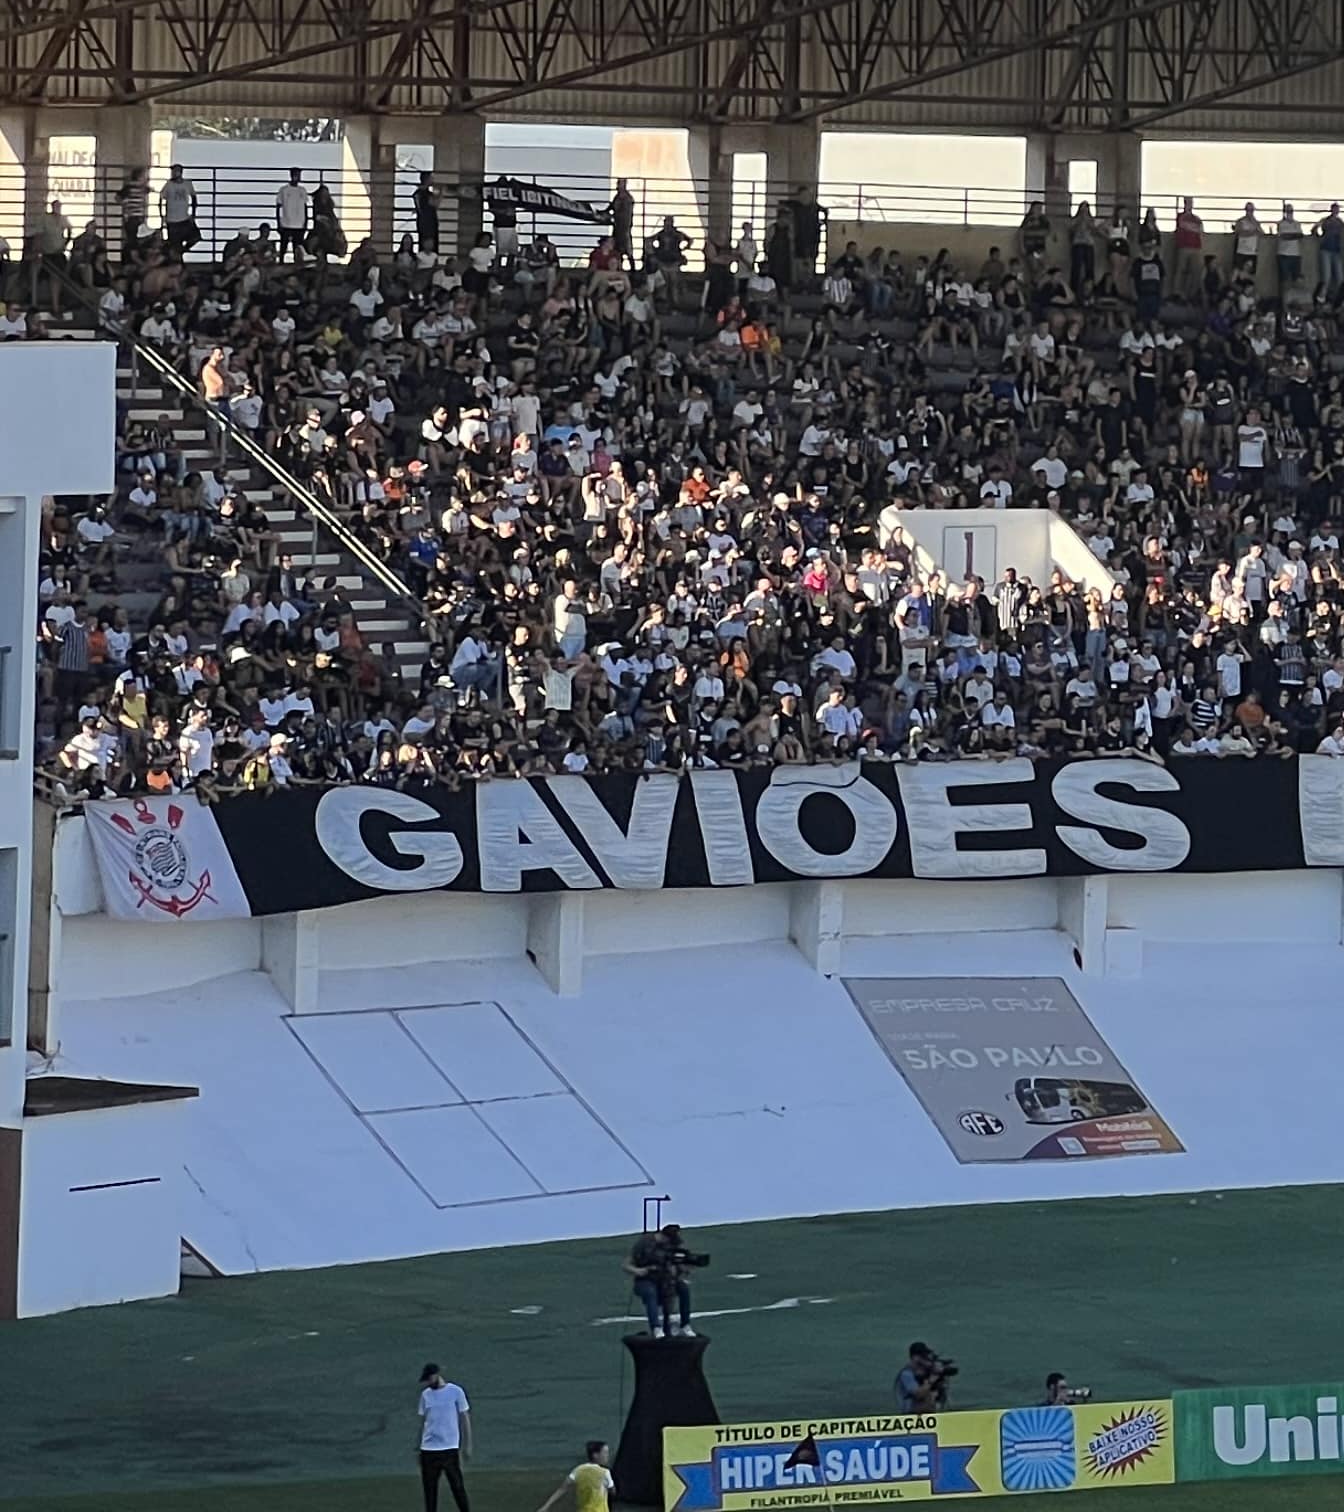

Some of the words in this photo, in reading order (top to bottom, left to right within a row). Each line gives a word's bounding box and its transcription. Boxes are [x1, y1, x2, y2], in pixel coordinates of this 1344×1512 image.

[483, 186, 519, 201] FIEL
[869, 997, 986, 1014] EMPRESA
[992, 997, 1059, 1013] CRUZ
[904, 1044, 979, 1069] SÃO
[984, 1045, 1104, 1067] PAULO
[715, 1426, 775, 1443] TÍTULO
[781, 1424, 802, 1438] DE
[807, 1414, 938, 1436] CAPITALIZAÇÃO
[1089, 1430, 1118, 1453] BAIXE
[1120, 1414, 1154, 1436] NOSSO
[825, 1440, 931, 1483] SAÚDE
[1099, 1430, 1156, 1466] APLICATIVO
